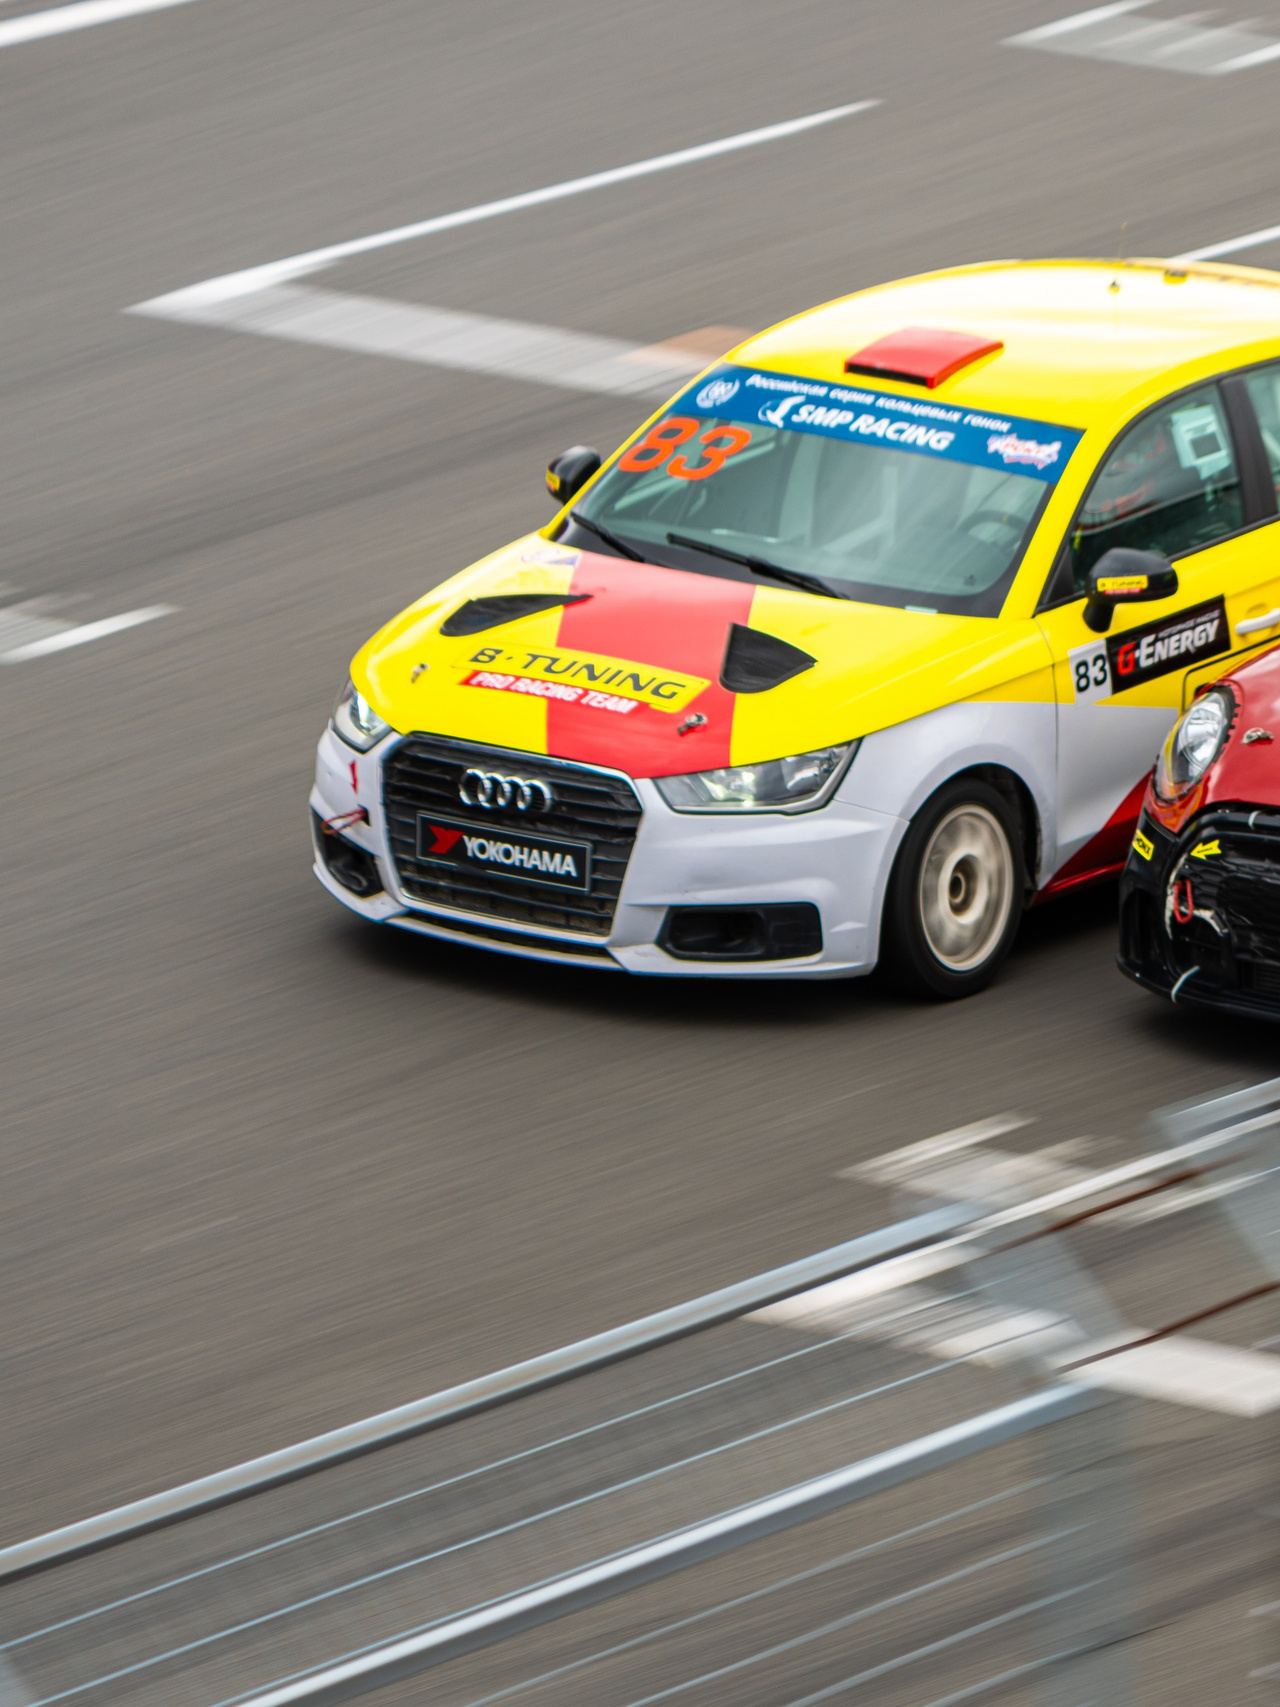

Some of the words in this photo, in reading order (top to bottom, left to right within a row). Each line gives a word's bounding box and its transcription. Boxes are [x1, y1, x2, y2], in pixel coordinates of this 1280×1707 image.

[616, 417, 752, 481] 83
[791, 404, 854, 428] SMP
[849, 413, 955, 451] RACING
[469, 671, 515, 690] PRO
[510, 678, 584, 702] RACING
[580, 688, 639, 714] TEAM
[1075, 653, 1107, 693] 83
[462, 835, 578, 877] YOKOHAMA
